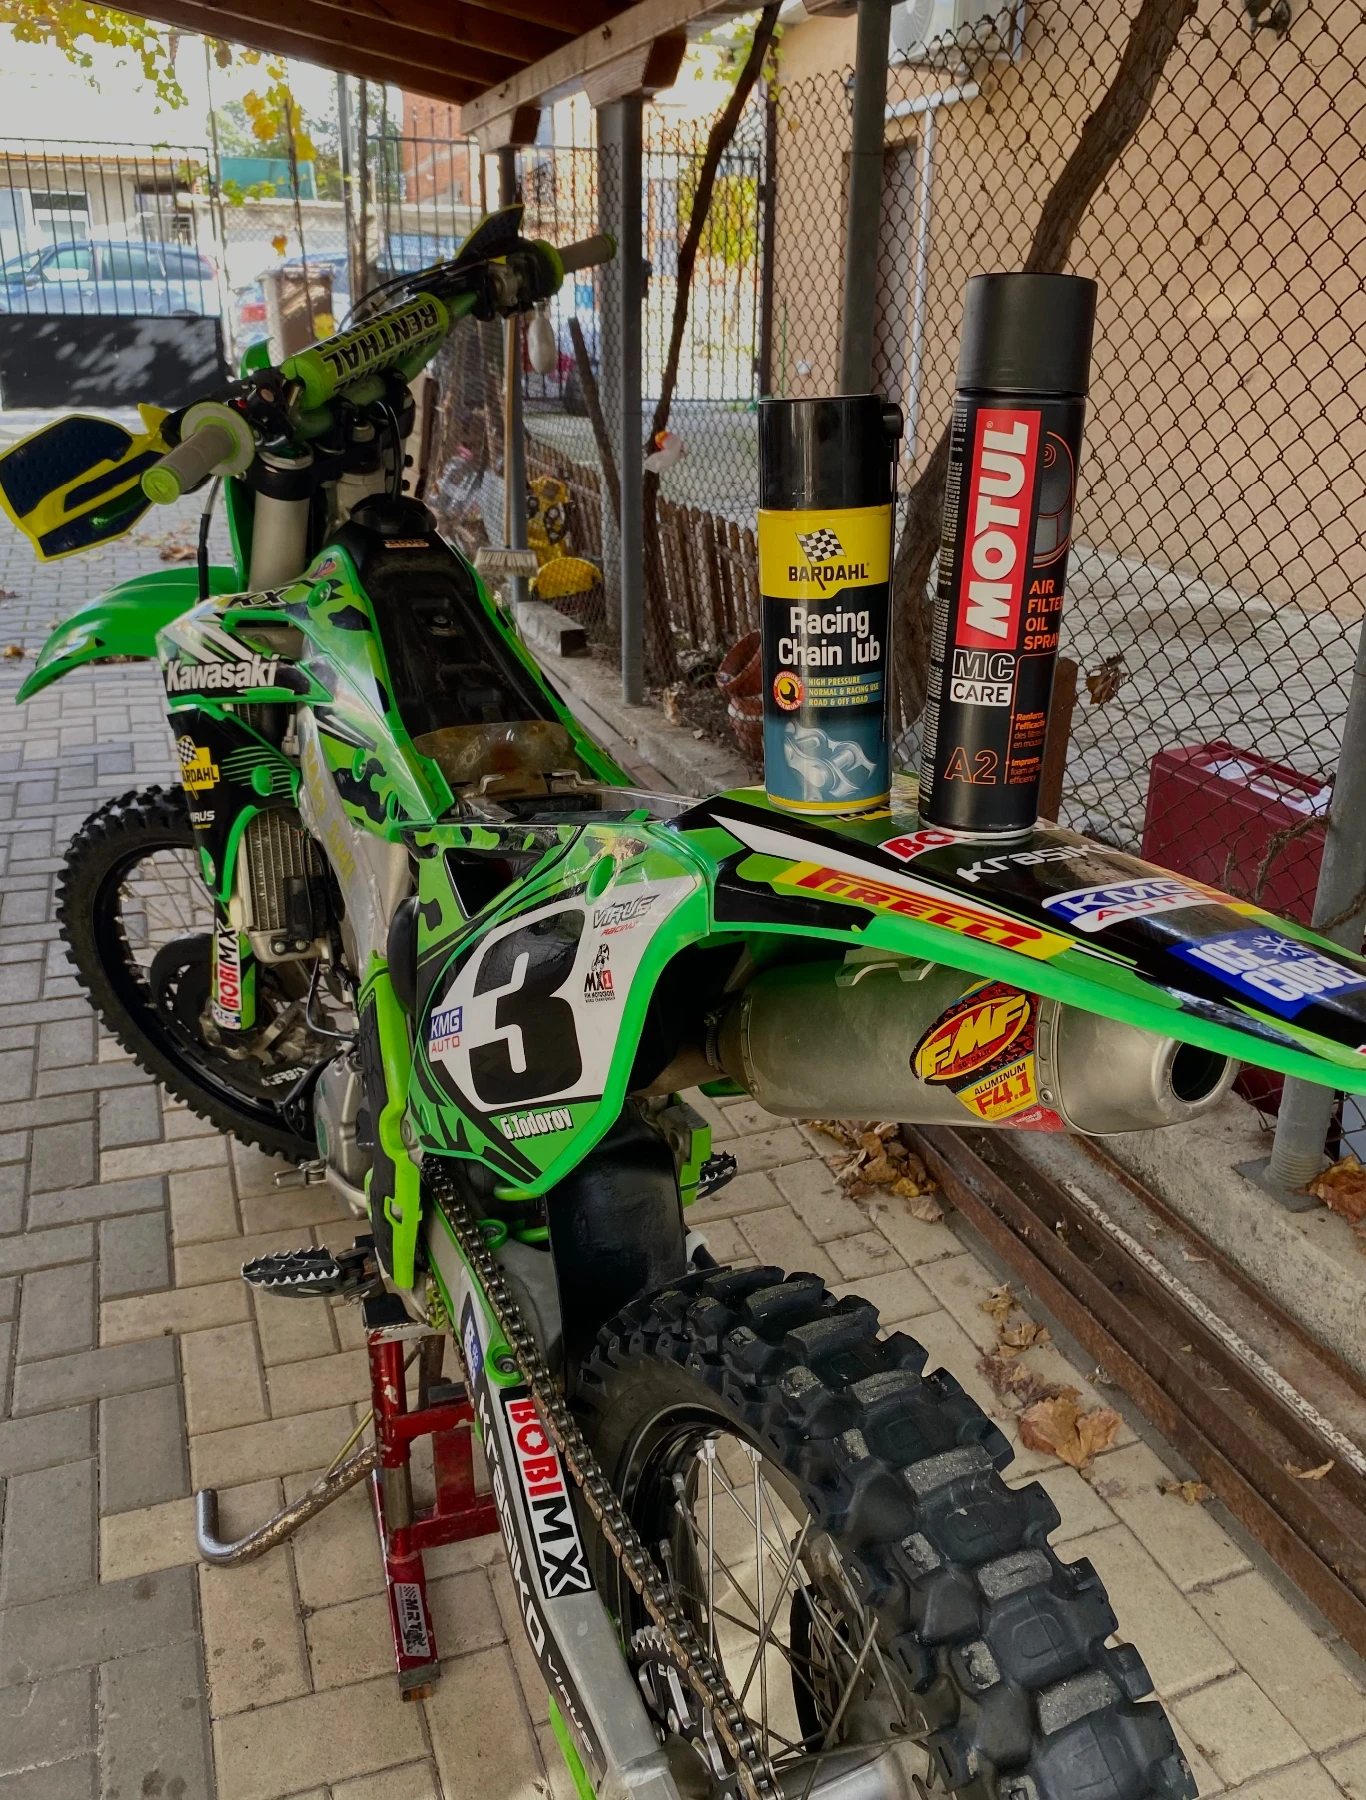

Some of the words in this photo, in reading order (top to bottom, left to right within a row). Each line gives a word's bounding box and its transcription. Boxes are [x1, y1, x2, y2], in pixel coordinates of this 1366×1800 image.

[323, 303, 439, 377] RENTHAL
[966, 421, 1029, 639] MOTUL
[788, 563, 869, 591] BARDAHL
[1029, 579, 1055, 595] AIR
[789, 605, 870, 639] Racing
[1025, 616, 1049, 632] OIL
[778, 637, 843, 666] Chain
[851, 634, 880, 664] lub
[952, 649, 1015, 681] MC
[167, 654, 280, 692] Kawasaki
[808, 678, 826, 686] HIGH
[828, 675, 861, 686] PRESSURE
[808, 687, 837, 696] NORMAL
[839, 687, 845, 695] &
[846, 685, 869, 695] RACING
[808, 698, 828, 706] ROAD
[830, 698, 836, 706] &
[838, 697, 850, 706] OFF
[851, 695, 868, 705] ROAD
[953, 682, 1009, 704] CARE
[944, 746, 998, 785] A2
[593, 894, 660, 929] VIRUS
[796, 867, 1043, 948] PIRELLI
[1059, 881, 1198, 913] KMG
[216, 920, 240, 1010] BOBIMX
[1186, 939, 1280, 976] ICE
[584, 970, 614, 992] MX1
[1241, 956, 1366, 1001] CUBE
[468, 908, 586, 1105] 3
[431, 1009, 460, 1039] KMG
[921, 993, 1026, 1079] FMF
[431, 1035, 461, 1054] AUTO
[974, 1062, 1026, 1096] ALUMINUM
[976, 1071, 1031, 1115] F4.1
[500, 1107, 576, 1141] G.Todorov
[509, 1400, 592, 1598] BOBIMX
[479, 1392, 547, 1659] krasiko
[404, 1598, 422, 1632] MRT
[547, 1662, 595, 1755] VIRUS
